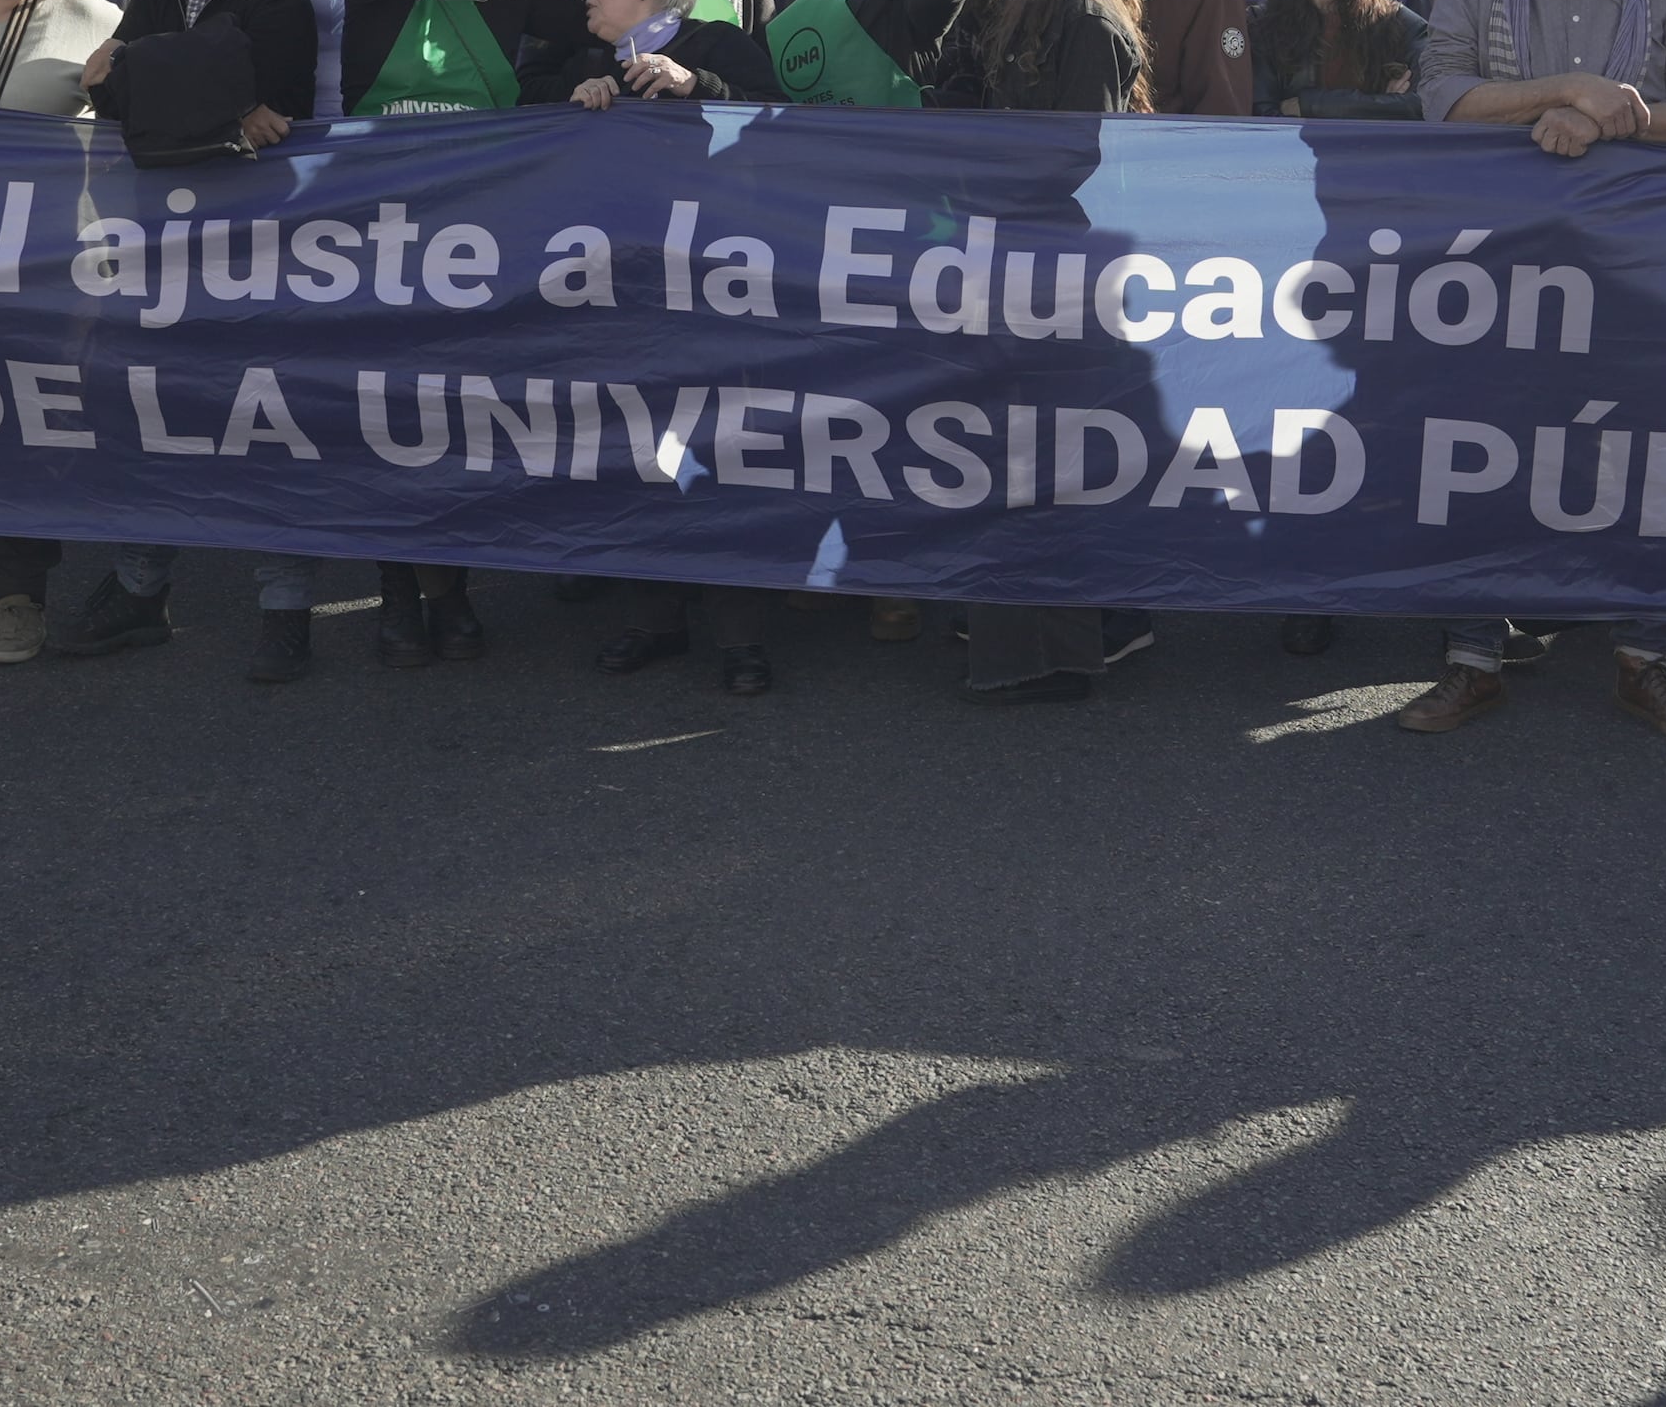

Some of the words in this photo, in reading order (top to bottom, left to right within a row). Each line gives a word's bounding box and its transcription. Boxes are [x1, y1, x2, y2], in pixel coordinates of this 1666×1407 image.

[785, 46, 820, 72] UNA
[70, 188, 500, 329] ajuste
[539, 225, 618, 308] a
[663, 200, 779, 318] la
[819, 204, 1595, 355] Educación
[128, 365, 322, 461] LA
[356, 369, 1367, 515] UNIVERSIDAD
